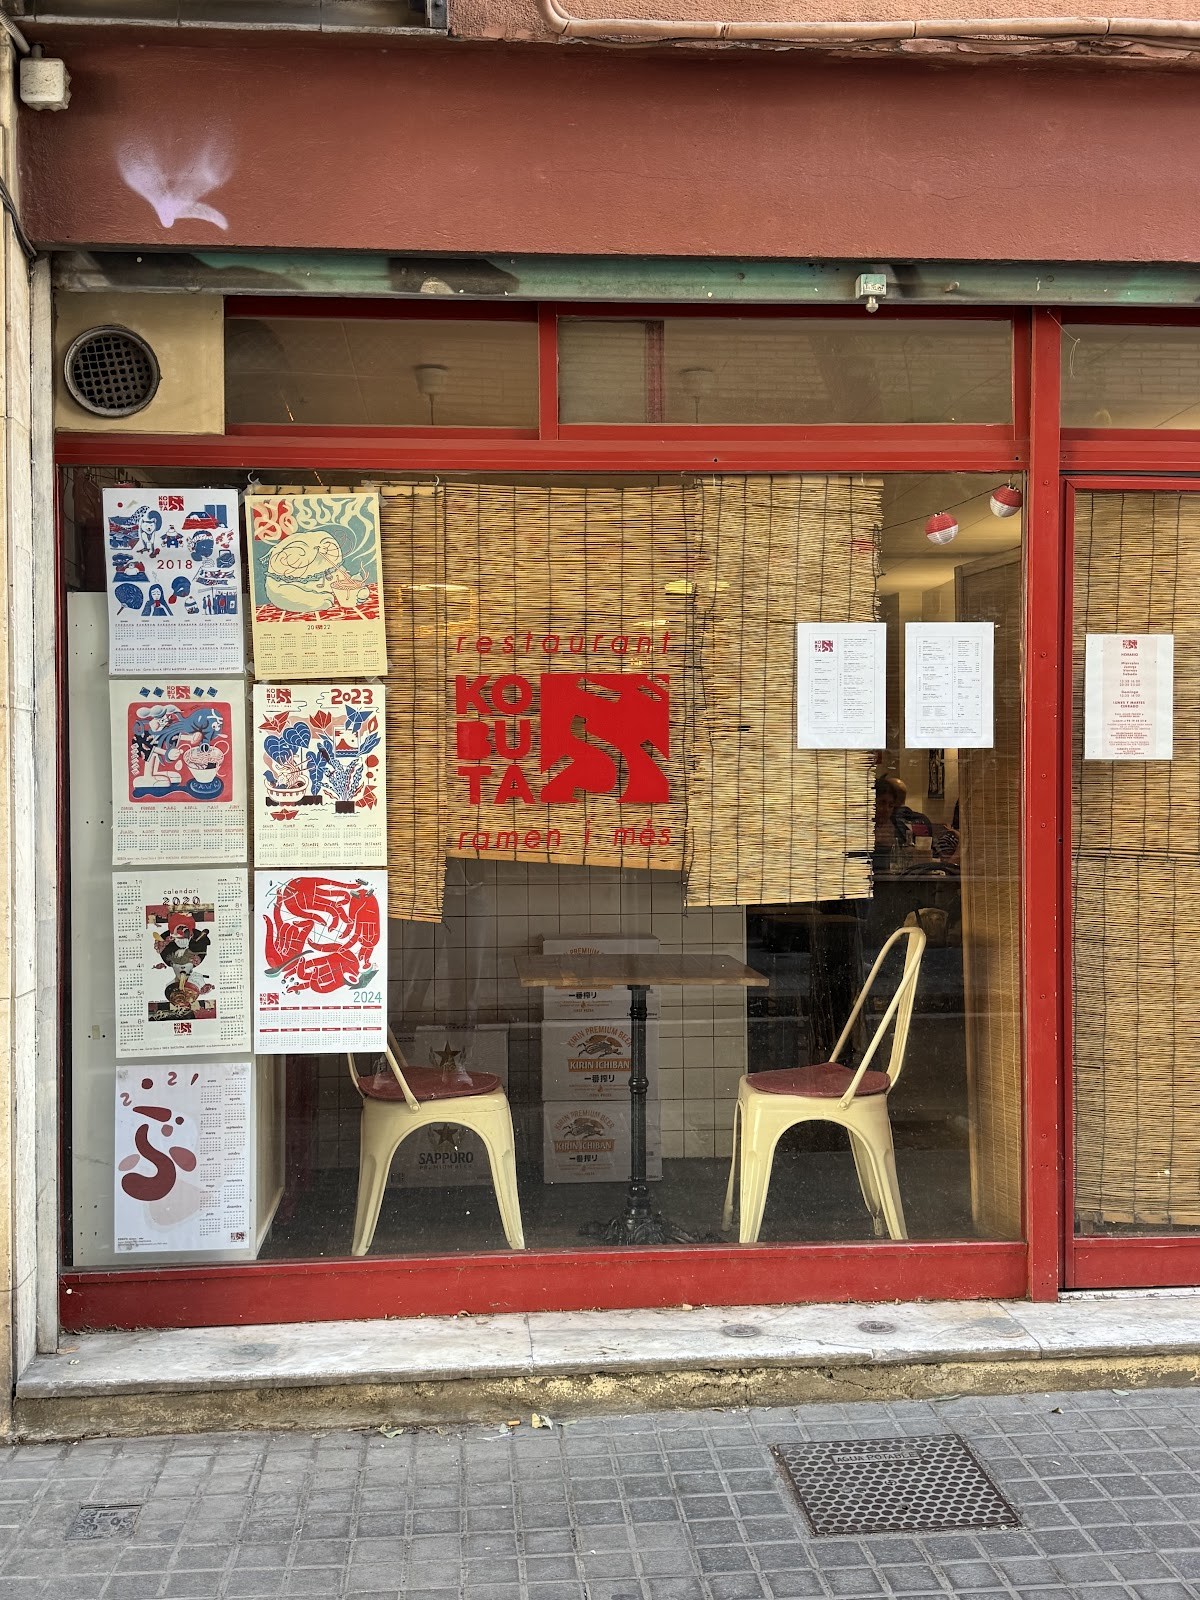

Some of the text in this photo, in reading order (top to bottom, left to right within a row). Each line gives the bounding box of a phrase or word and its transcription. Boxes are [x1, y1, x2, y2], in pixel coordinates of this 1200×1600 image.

[157, 560, 193, 570] 2018
[456, 631, 671, 654] restaurant
[331, 688, 373, 704] 2023
[455, 674, 533, 715] KO
[457, 720, 531, 760] BU
[457, 765, 535, 805] TA
[458, 819, 671, 850] ramen i més
[163, 896, 200, 906] 2020
[353, 991, 382, 1003] 2024
[567, 1030, 585, 1047] KIRIN
[585, 1026, 618, 1035] PREMIUM
[570, 1061, 630, 1070] KIRIN ICHIBAN
[556, 1141, 612, 1150] KIRIN ICHIBAN
[419, 1152, 474, 1164] SAPPORO
[837, 1451, 919, 1463] AGUA POTABLE
